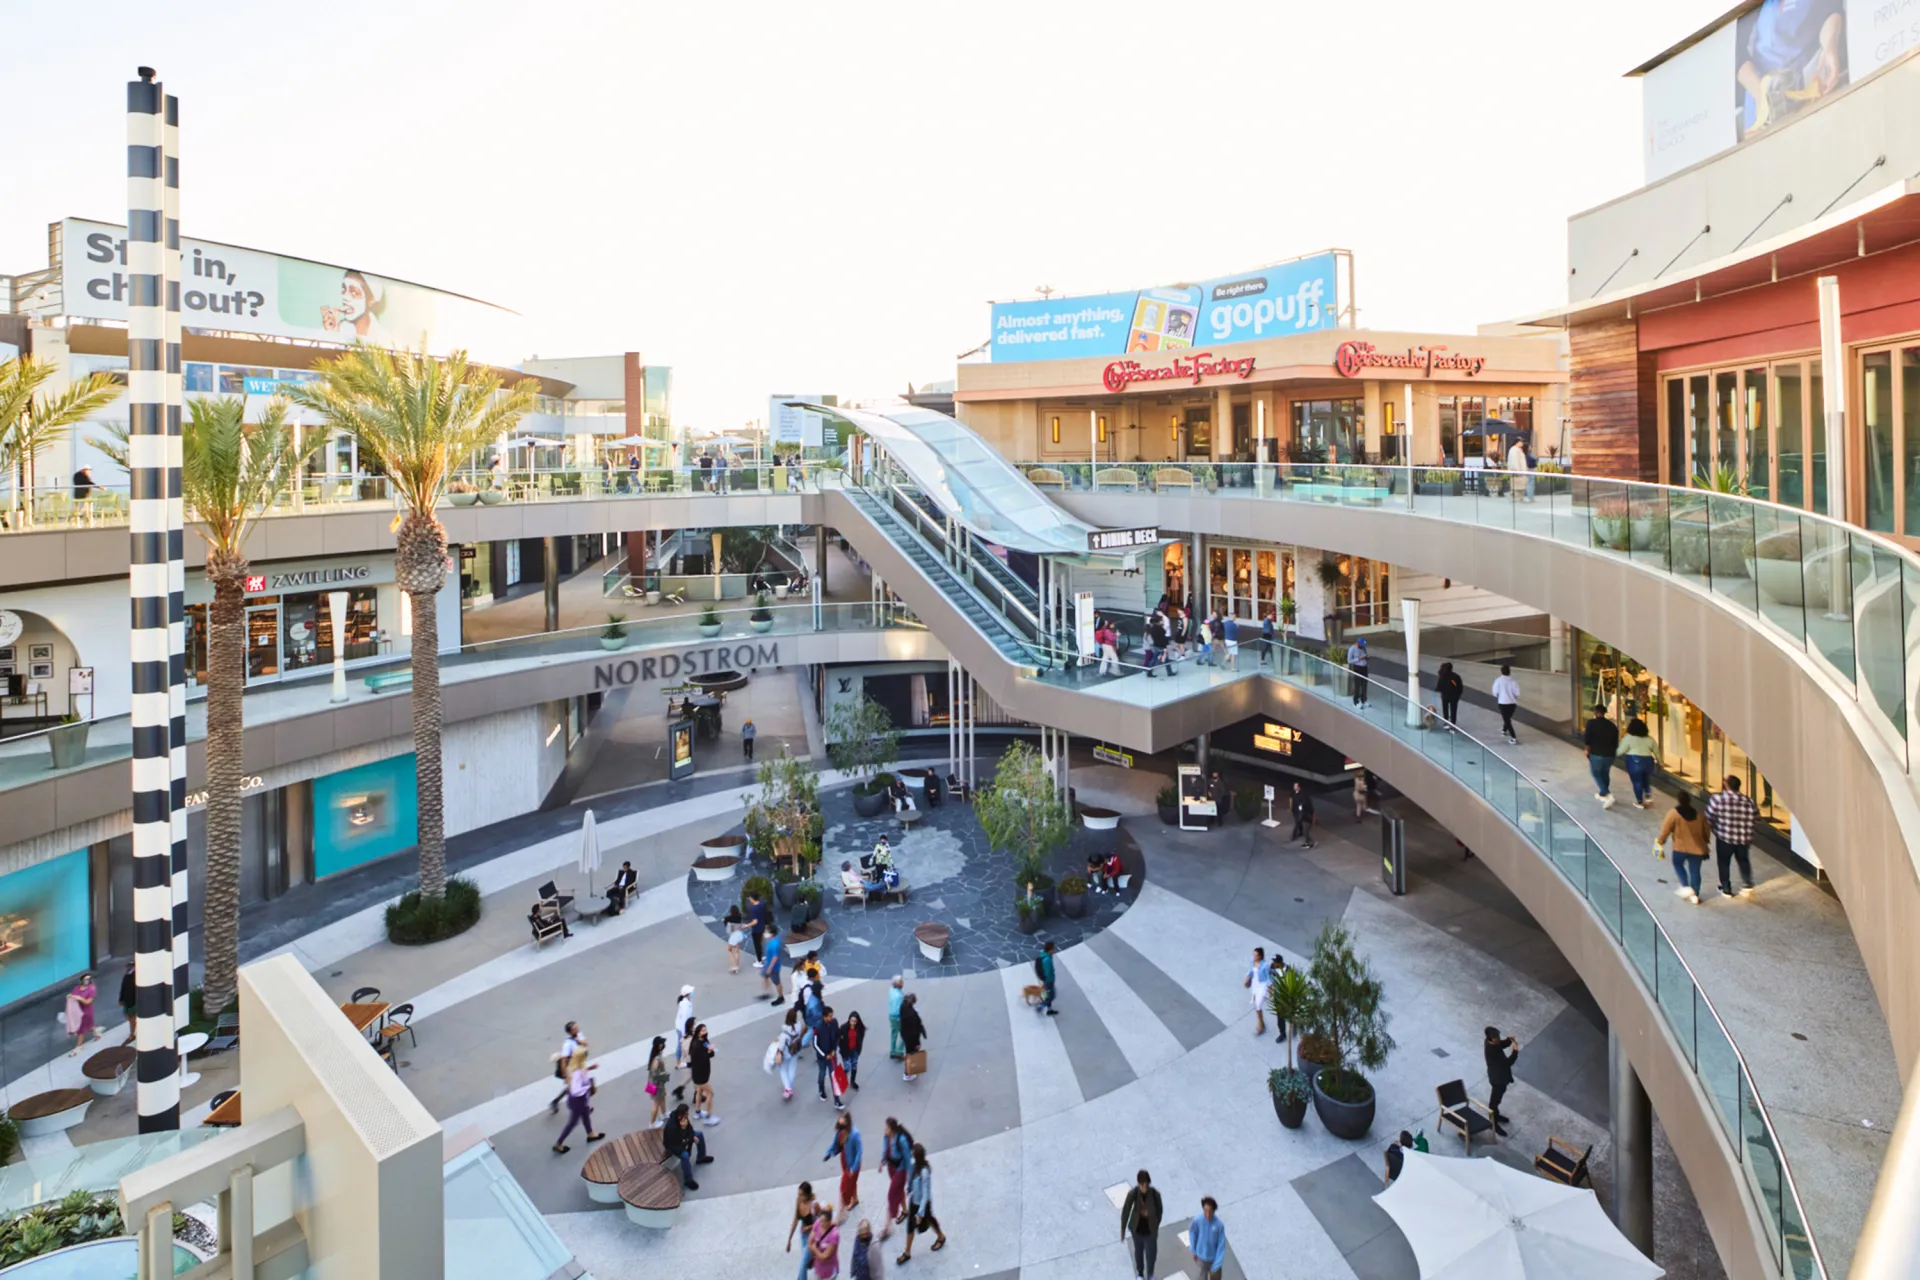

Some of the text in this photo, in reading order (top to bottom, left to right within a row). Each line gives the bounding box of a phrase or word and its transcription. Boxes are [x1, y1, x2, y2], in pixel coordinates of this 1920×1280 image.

[1875, 29, 1906, 61] GIFT
[193, 248, 236, 286] in,
[184, 289, 265, 317] out?
[1215, 282, 1266, 297] Be right there.
[996, 306, 1125, 330] Almost anything,
[1209, 277, 1325, 340] gopuff
[997, 324, 1105, 345] delivered fast.
[1102, 352, 1257, 393] The Cheesecake Factory
[1334, 340, 1487, 378] The Cheesecake Factory
[1100, 528, 1158, 548] DINING DECK
[272, 566, 370, 589] ZWILLING
[594, 642, 779, 689] NORDSTROM
